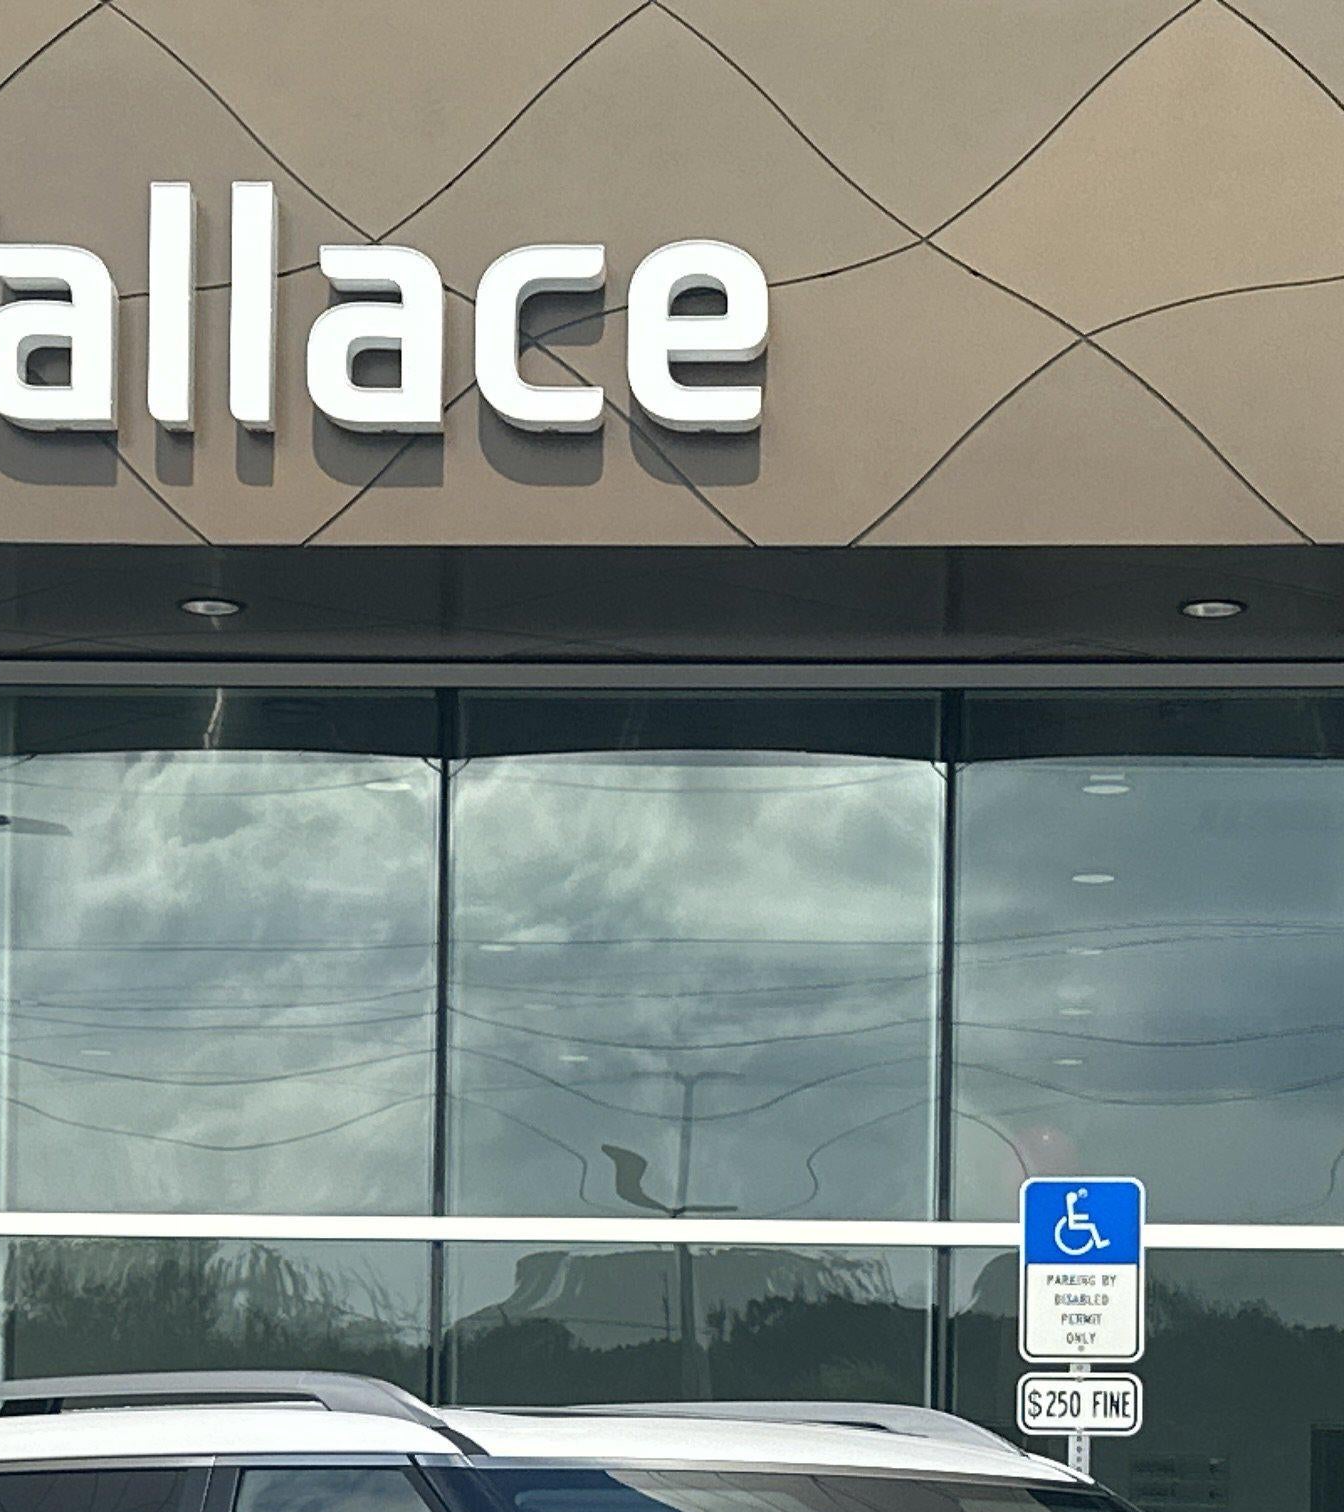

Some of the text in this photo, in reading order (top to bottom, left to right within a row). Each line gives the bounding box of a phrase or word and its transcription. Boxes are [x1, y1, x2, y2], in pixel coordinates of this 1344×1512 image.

[1046, 1274, 1117, 1287] PARKING BY
[1054, 1293, 1110, 1306] DISABLED
[1061, 1313, 1102, 1325] PERMIT
[1066, 1332, 1096, 1344] ONLY
[1028, 1388, 1131, 1420] $250 FINE
